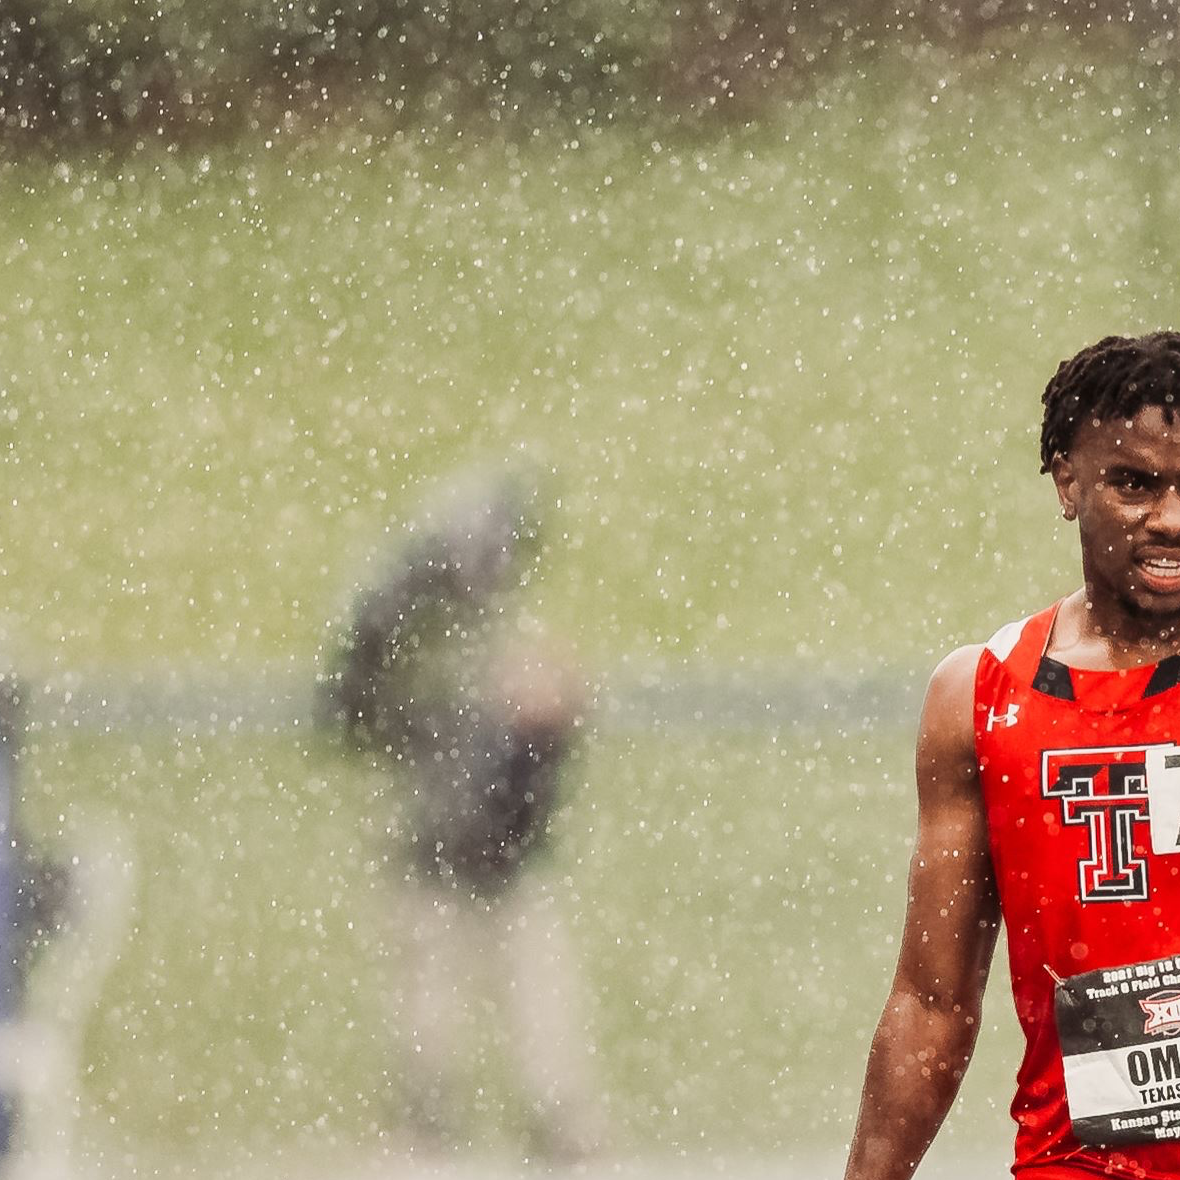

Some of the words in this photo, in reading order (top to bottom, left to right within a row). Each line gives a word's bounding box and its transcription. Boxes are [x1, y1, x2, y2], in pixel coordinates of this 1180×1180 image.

[1103, 968, 1132, 983] 2021
[1135, 965, 1155, 977] Big
[1158, 960, 1174, 973] 12
[1086, 985, 1119, 999] Track
[1132, 976, 1160, 991] Field
[1110, 1115, 1158, 1131] Kansas
[1154, 1125, 1180, 1139] May
